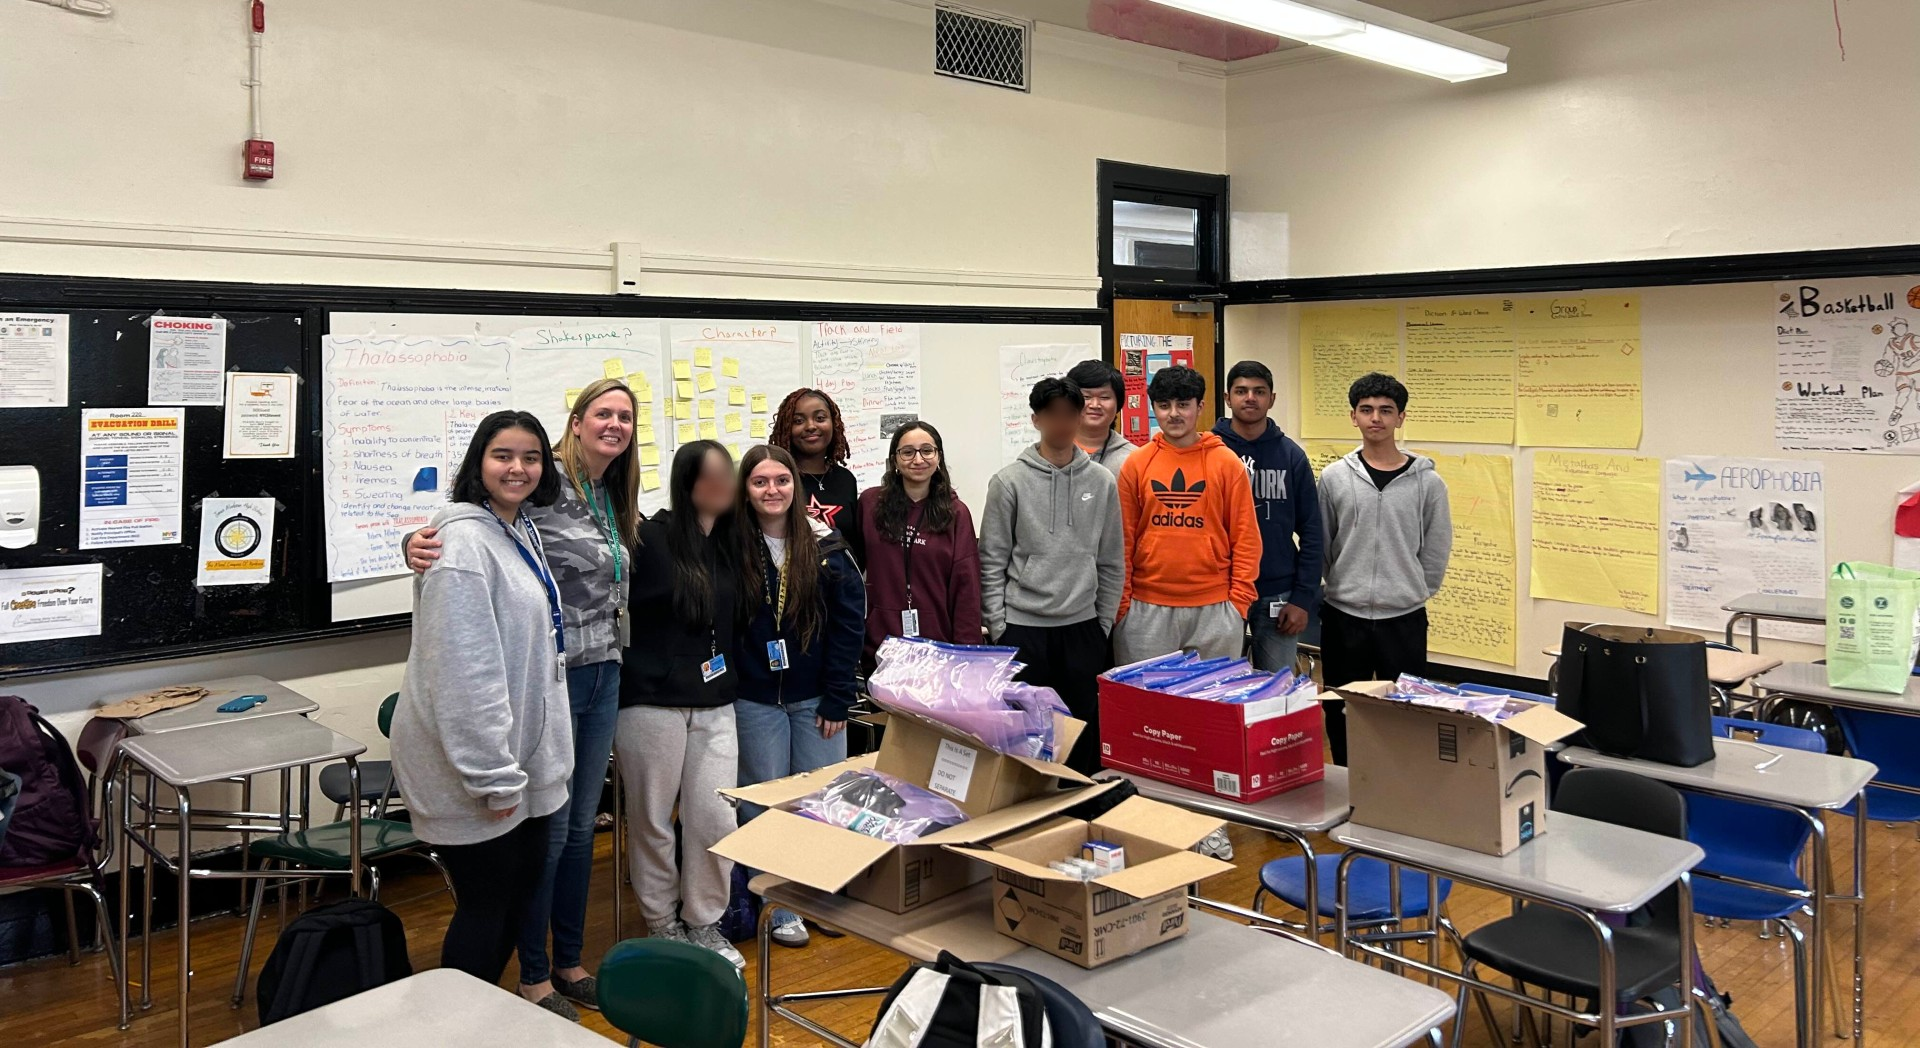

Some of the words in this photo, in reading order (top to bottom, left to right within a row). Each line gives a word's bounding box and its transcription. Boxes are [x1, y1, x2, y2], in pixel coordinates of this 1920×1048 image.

[254, 156, 272, 165] FIRE
[1550, 299, 1578, 315] Group
[1799, 286, 1894, 317] Basketball
[154, 321, 213, 330] CHOKING
[817, 322, 847, 337] Track
[853, 325, 870, 334] and
[880, 324, 903, 336] Field
[1121, 334, 1156, 348] PICTURING
[1158, 335, 1173, 347] THE
[345, 347, 468, 368] Thalassophobia
[816, 378, 823, 390] 4
[825, 380, 837, 390] day
[1861, 386, 1885, 398] Plan
[372, 398, 385, 406] the
[430, 398, 449, 406] other
[452, 398, 472, 407] large
[475, 398, 502, 406] bodies
[460, 410, 476, 420] Key
[91, 420, 149, 428] EVACUATION
[150, 419, 177, 427] DRILL
[351, 437, 387, 446] Inability
[399, 435, 442, 443] concentrate
[415, 450, 443, 459] breath
[353, 460, 393, 471] Nausea
[1606, 458, 1630, 473] And
[354, 474, 397, 485] Tremors
[1721, 466, 1822, 492] AEROPHOBIA
[354, 488, 403, 501] Sweating
[387, 503, 411, 511] change
[1151, 512, 1204, 529] adidas
[79, 596, 93, 605] Future
[1143, 725, 1161, 738] Copy
[1161, 729, 1182, 741] Paper
[1271, 736, 1287, 746] Copy
[1287, 731, 1304, 741] Paper
[1103, 744, 1110, 752] 10
[937, 769, 946, 777] DO
[945, 772, 956, 781] NOT
[934, 782, 957, 796] SEPARATE
